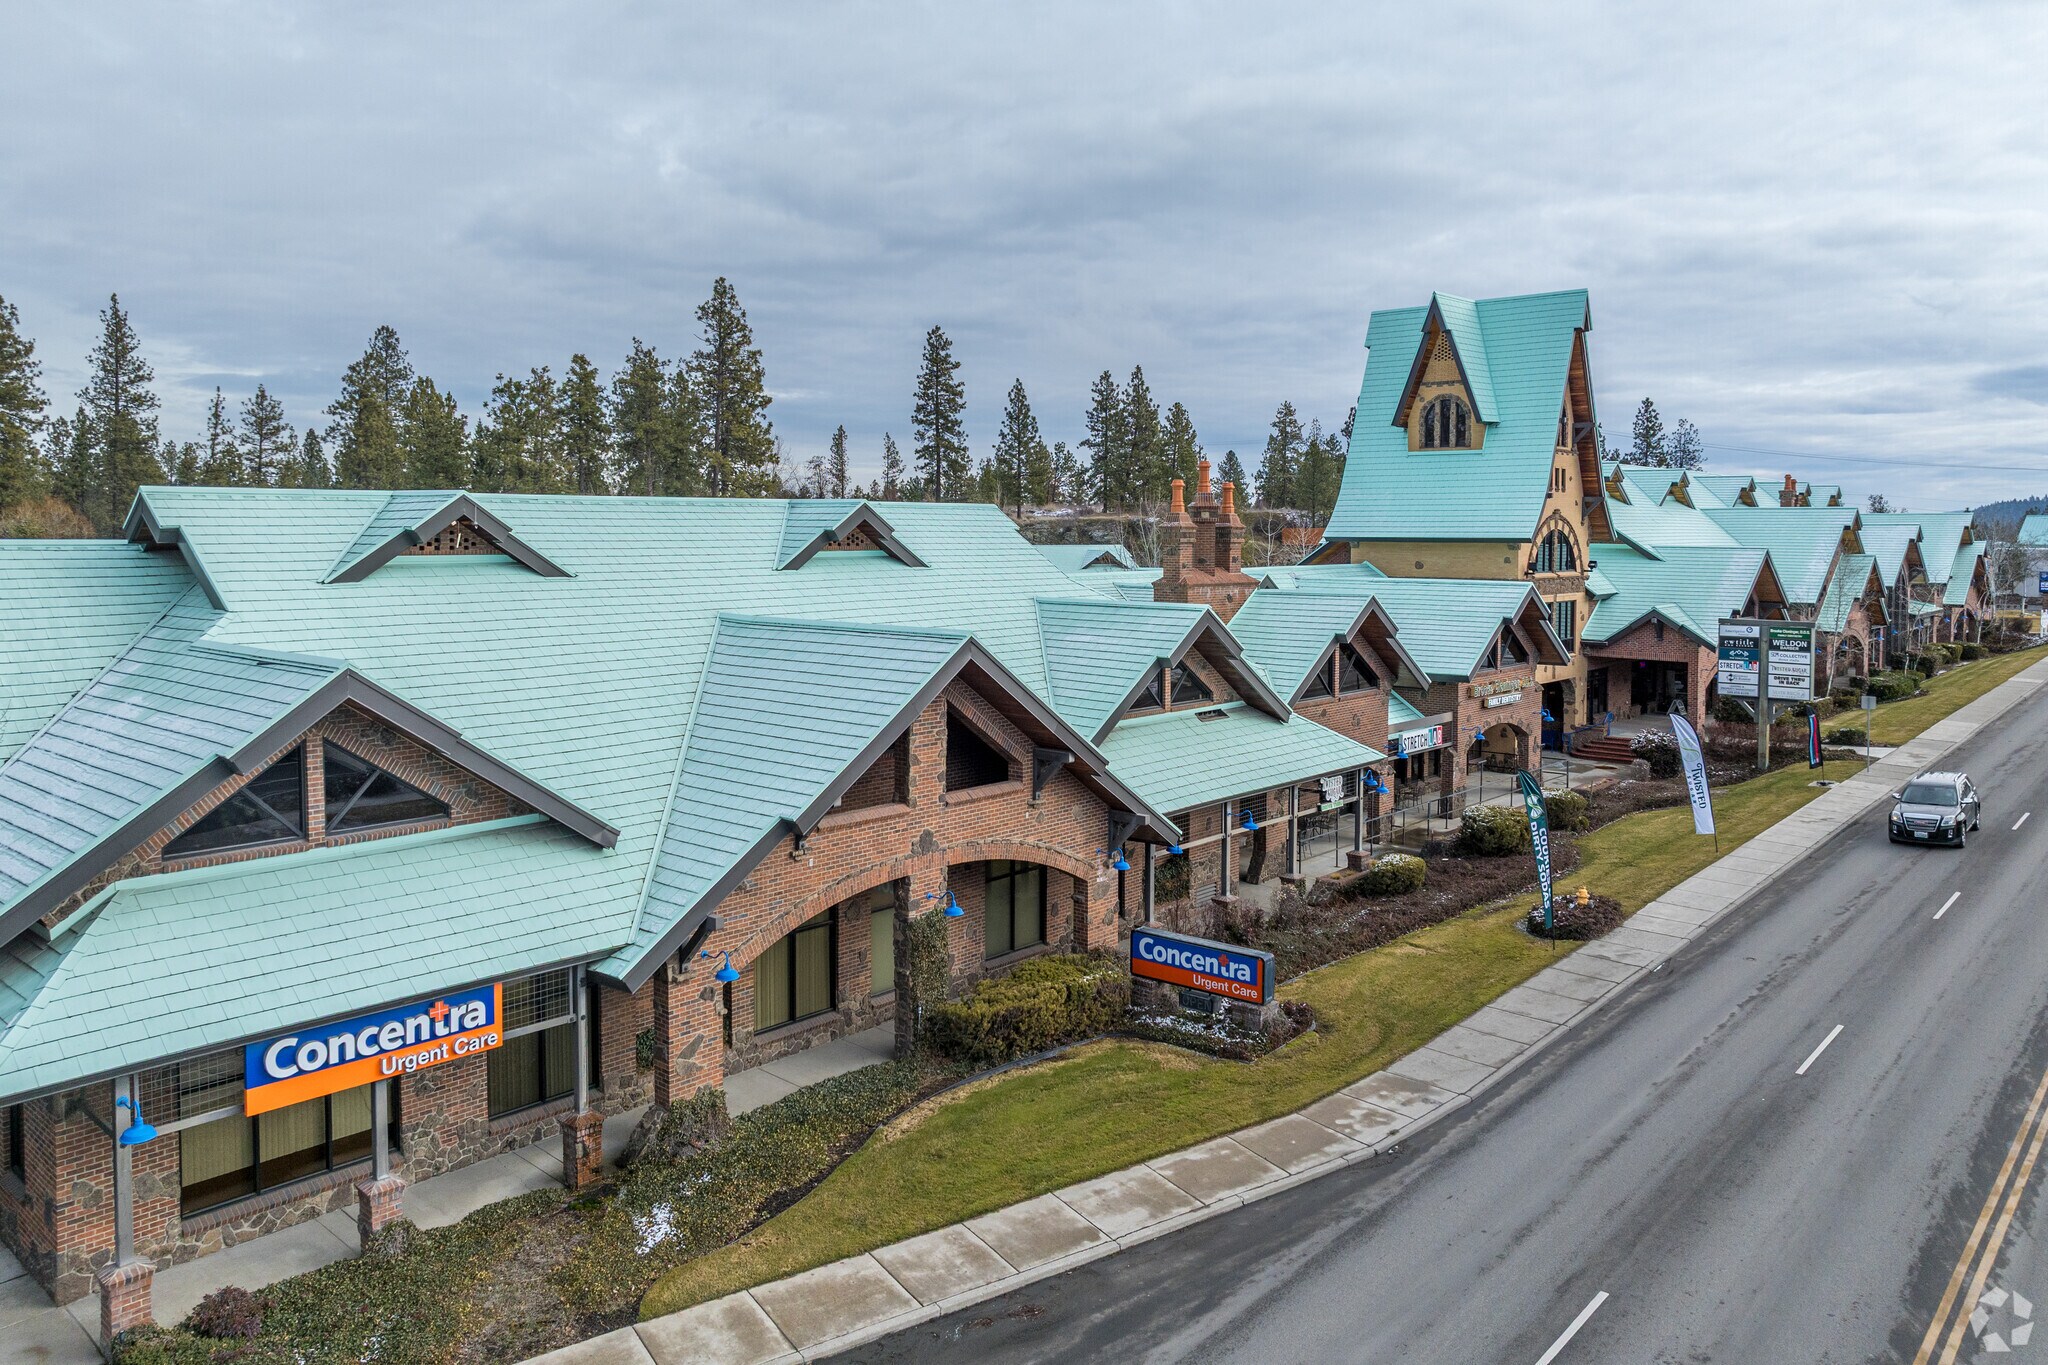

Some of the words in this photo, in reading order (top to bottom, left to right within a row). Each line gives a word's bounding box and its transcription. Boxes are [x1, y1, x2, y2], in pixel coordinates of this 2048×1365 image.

[1772, 640, 1807, 648] WELDON
[1501, 694, 1521, 704] DENTISTRY
[1530, 822, 1543, 860] DIRTY
[1538, 865, 1550, 909] SODAS
[1139, 937, 1250, 982] Concentra
[1193, 974, 1229, 992] Urgent
[1231, 984, 1258, 999] Care
[1182, 996, 1213, 1011] OPEN
[264, 1000, 486, 1079] Concentra
[381, 1043, 449, 1075] Urgent
[453, 1033, 498, 1055] Care
